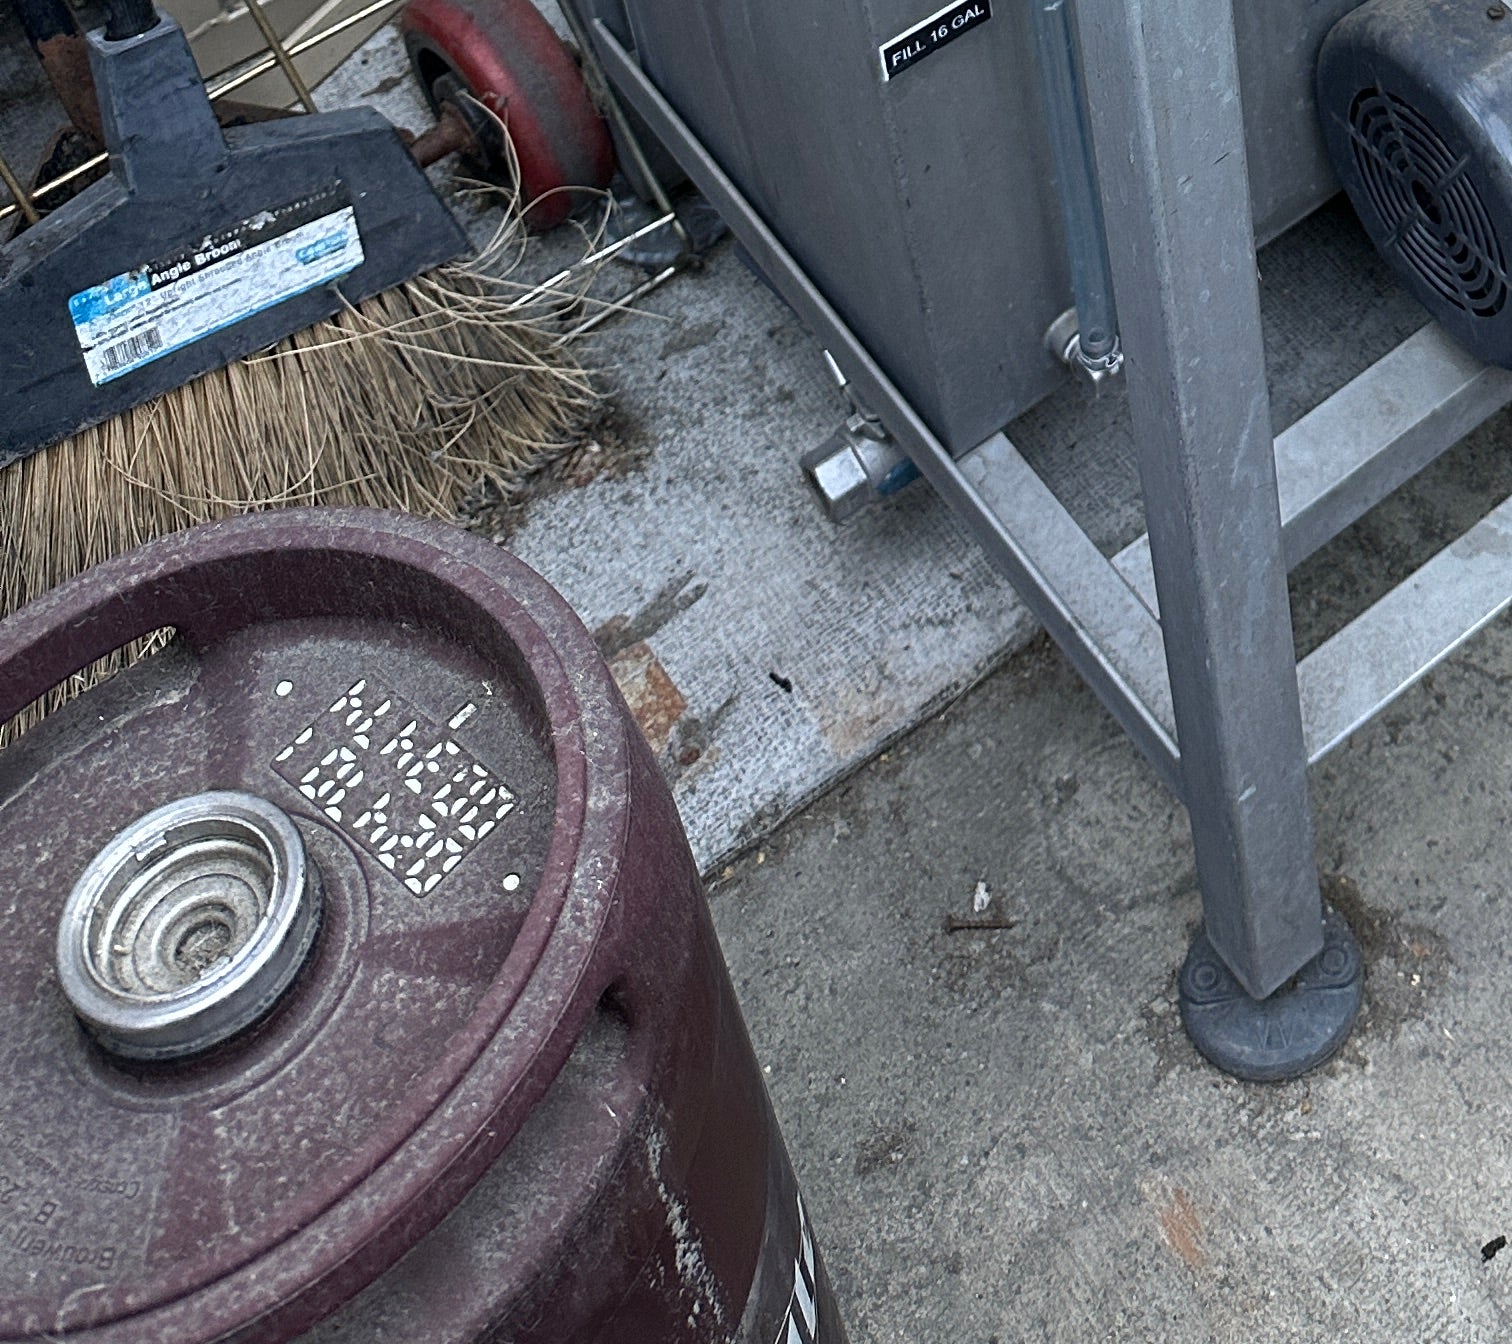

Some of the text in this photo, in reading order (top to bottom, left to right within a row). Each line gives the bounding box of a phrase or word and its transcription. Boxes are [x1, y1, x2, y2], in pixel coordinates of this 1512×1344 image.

[891, 3, 986, 68] FILL 16 GAL
[103, 280, 147, 307] Large
[150, 260, 192, 287] Angle
[193, 238, 242, 266] Broom
